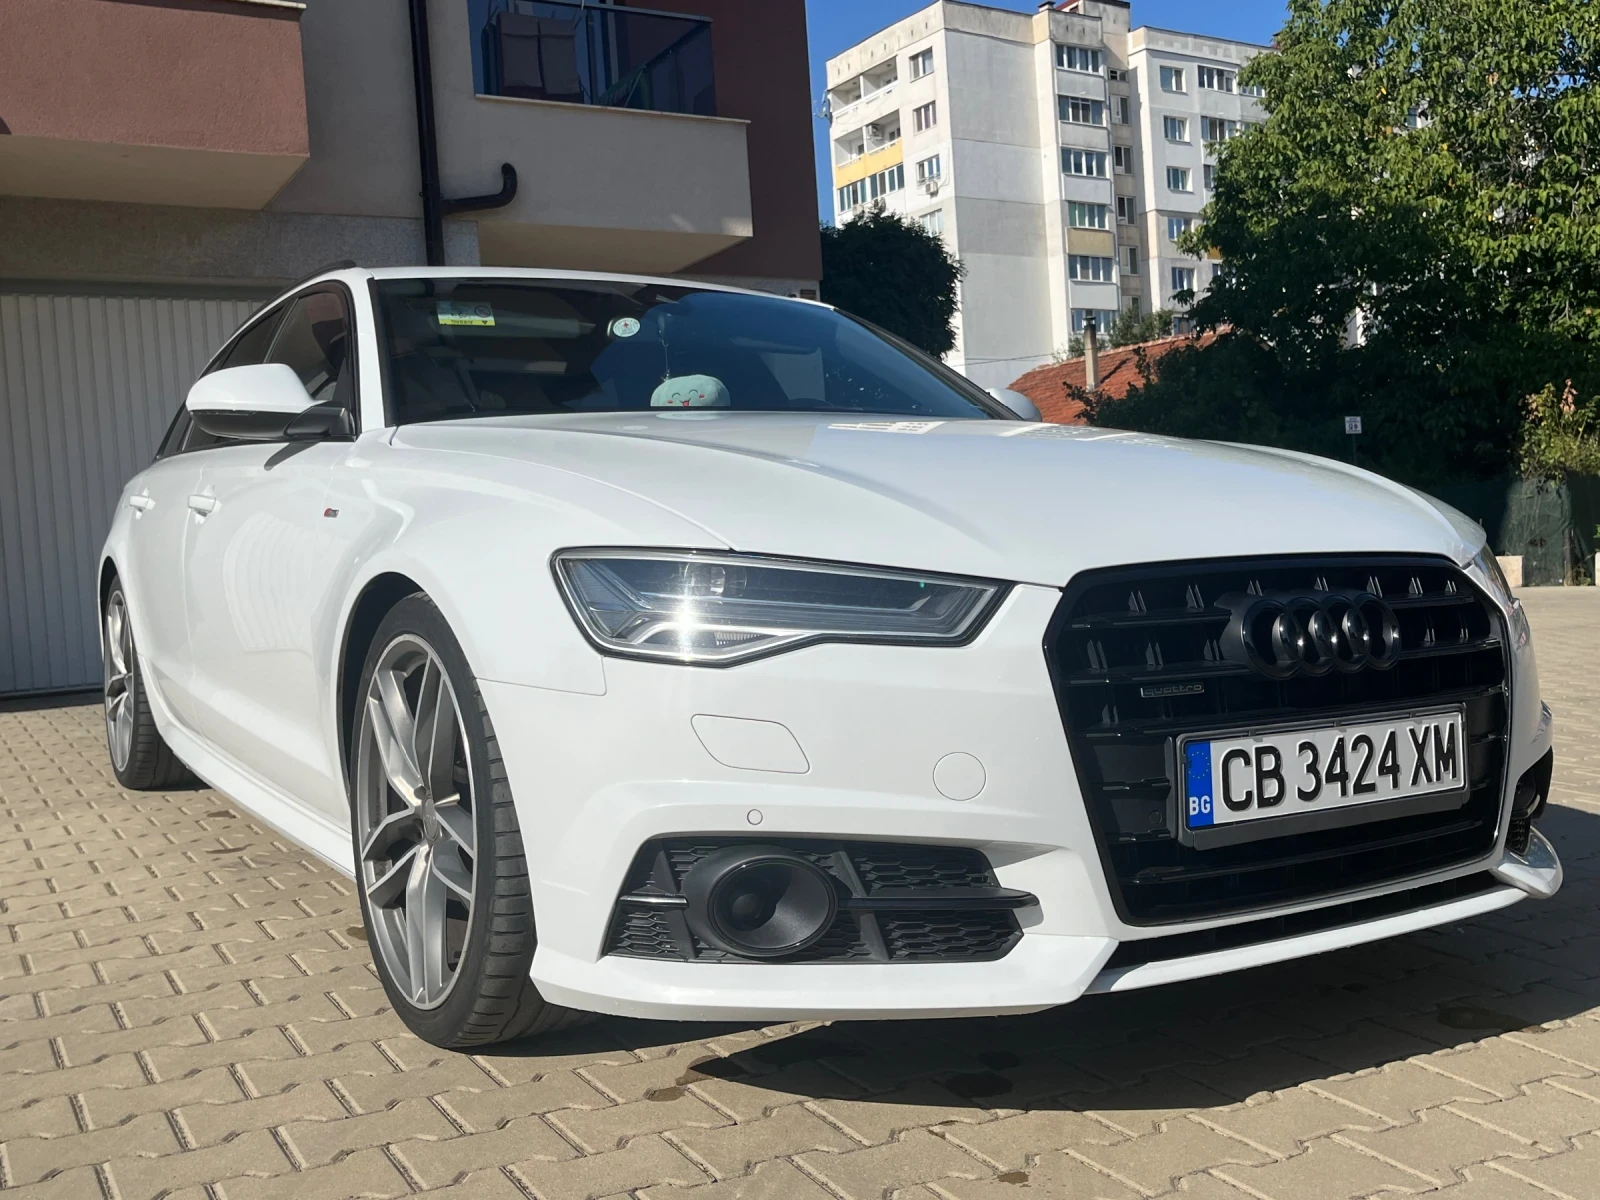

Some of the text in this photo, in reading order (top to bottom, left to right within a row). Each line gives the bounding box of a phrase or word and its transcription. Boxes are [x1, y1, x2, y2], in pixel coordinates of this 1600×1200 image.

[1143, 684, 1203, 696] quattro
[1221, 721, 1458, 812] CB 3424 XM
[1189, 795, 1211, 816] BG
